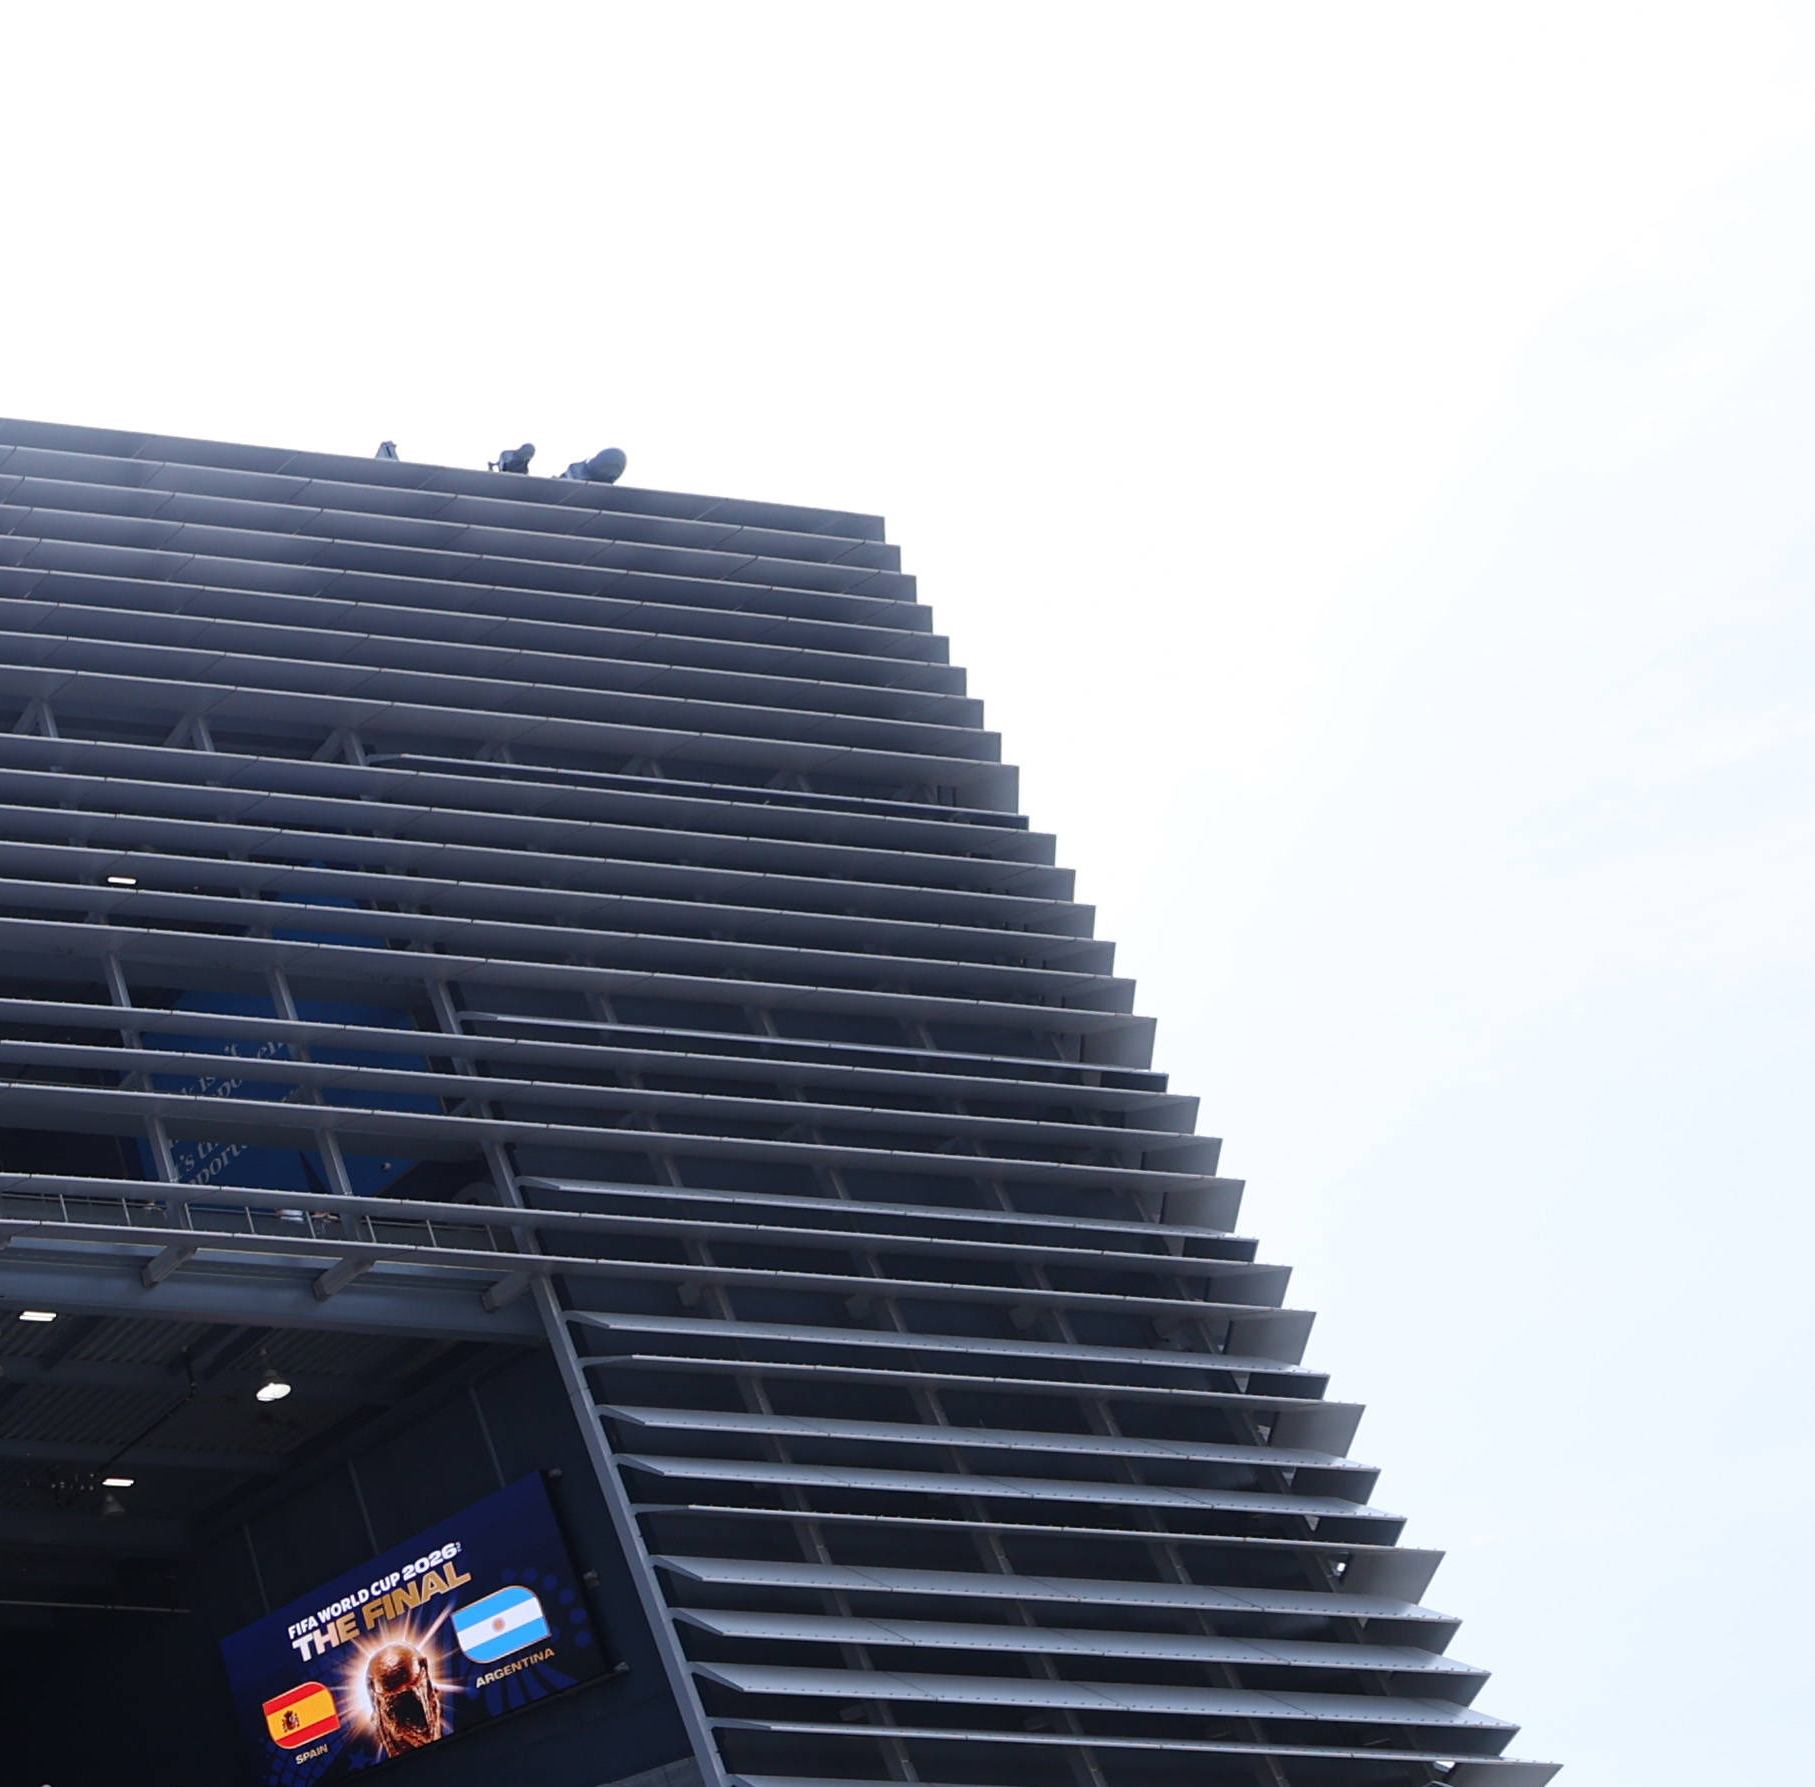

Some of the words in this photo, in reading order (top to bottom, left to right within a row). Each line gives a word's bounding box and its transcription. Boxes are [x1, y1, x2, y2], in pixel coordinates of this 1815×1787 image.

[288, 1616, 318, 1640] FIFA
[317, 1588, 370, 1625] WORLD
[369, 1571, 401, 1598] CUP
[292, 1611, 360, 1662] THE
[361, 1561, 472, 1630] FINAL
[475, 1647, 555, 1688] ARGENTINA
[295, 1743, 329, 1765] SPAIN
